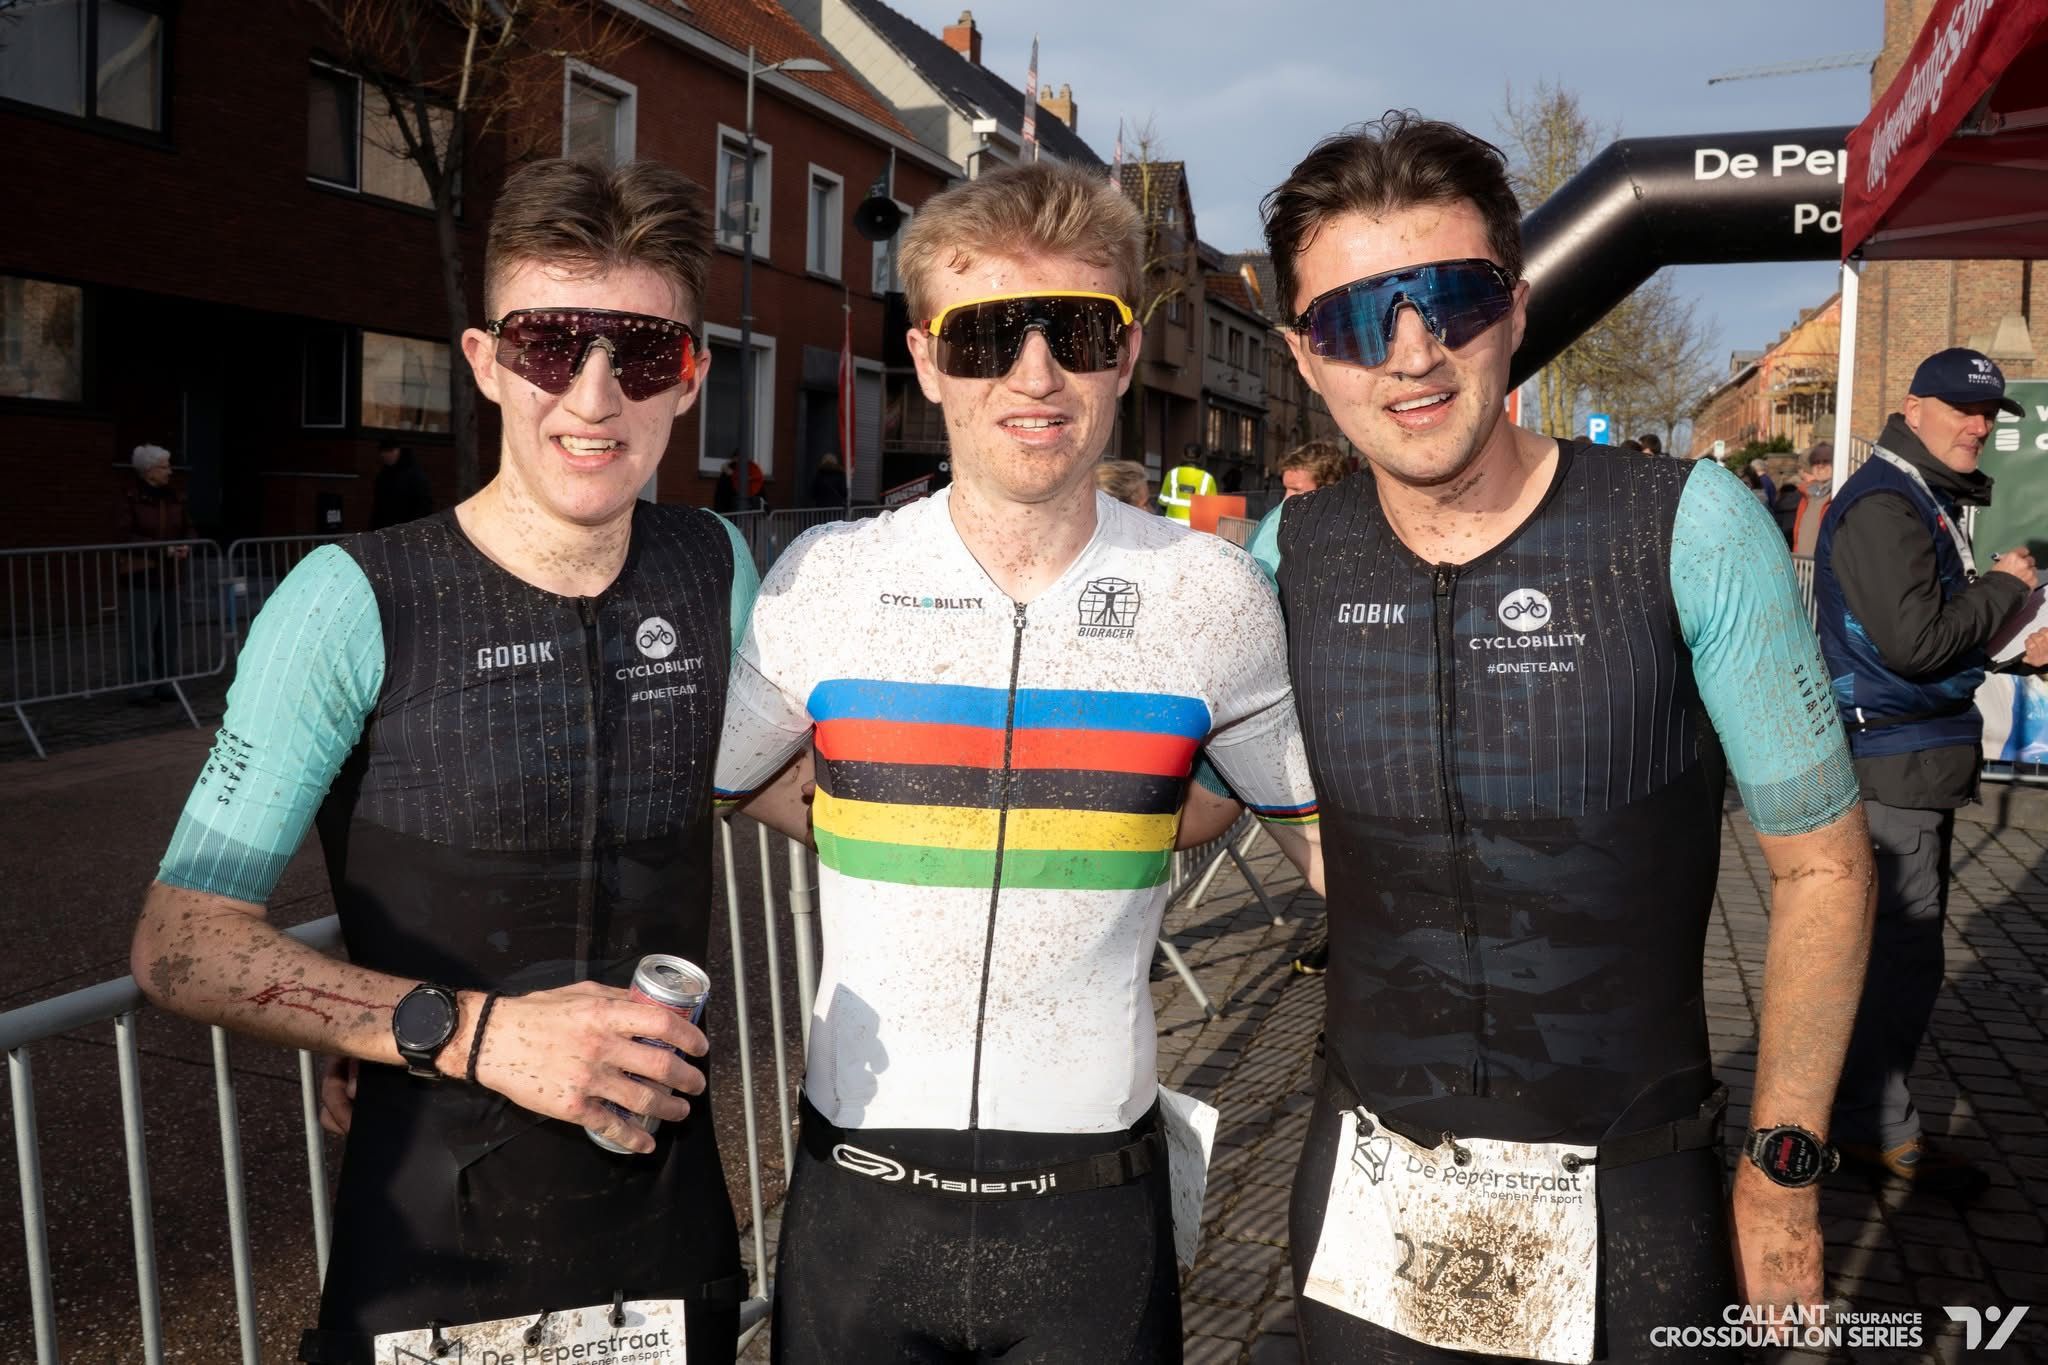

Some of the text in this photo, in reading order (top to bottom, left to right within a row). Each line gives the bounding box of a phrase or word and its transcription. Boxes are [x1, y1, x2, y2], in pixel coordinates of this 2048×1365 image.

[1694, 148, 1759, 180] De
[1590, 418, 1607, 442] P
[880, 593, 983, 610] CYCLOBILITY
[1338, 603, 1408, 625] GOBIK
[1077, 626, 1135, 640] BIORACER
[1469, 633, 1587, 650] CYCLOBILITY
[477, 641, 555, 670] GOBIK
[615, 656, 704, 680] CYCLOBILITY
[1486, 660, 1576, 674] #ONETEAM
[630, 683, 699, 702] #ONETEAM
[1405, 1154, 1582, 1193] De Peperstraat
[1532, 1193, 1547, 1204] en
[1550, 1194, 1583, 1205] sport
[482, 1328, 670, 1365] De Peperstraat
[621, 1354, 636, 1363] en
[638, 1348, 672, 1362] sport
